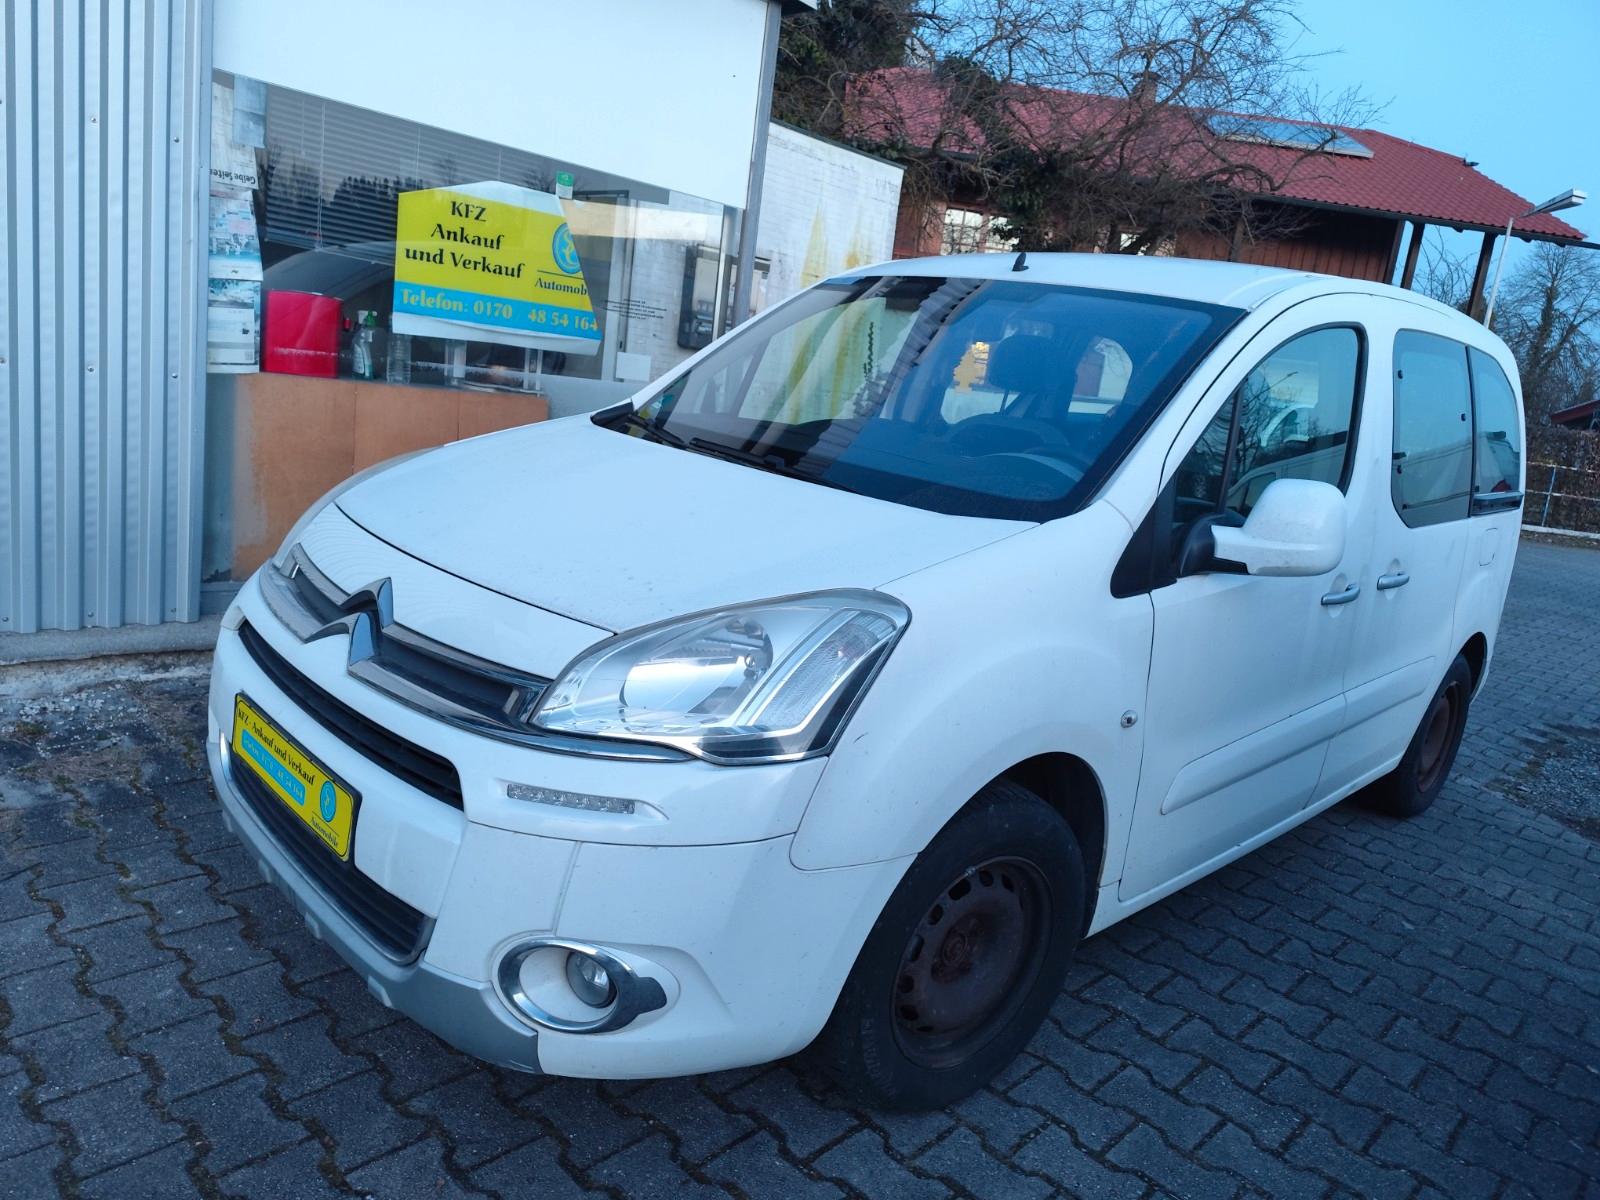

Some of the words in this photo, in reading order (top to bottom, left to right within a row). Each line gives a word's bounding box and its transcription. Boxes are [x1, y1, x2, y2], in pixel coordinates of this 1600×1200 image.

[451, 201, 488, 222] KFZ
[431, 223, 504, 250] Ankauf
[405, 247, 445, 265] und
[450, 252, 525, 278] Verkauf
[401, 289, 468, 313] Telefon:
[473, 301, 513, 320] 0170
[528, 309, 546, 324] 48
[551, 312, 569, 328] 54
[574, 315, 599, 332] 164
[252, 721, 274, 748] Ankauf
[274, 744, 287, 760] und
[288, 754, 316, 786] Verkauf
